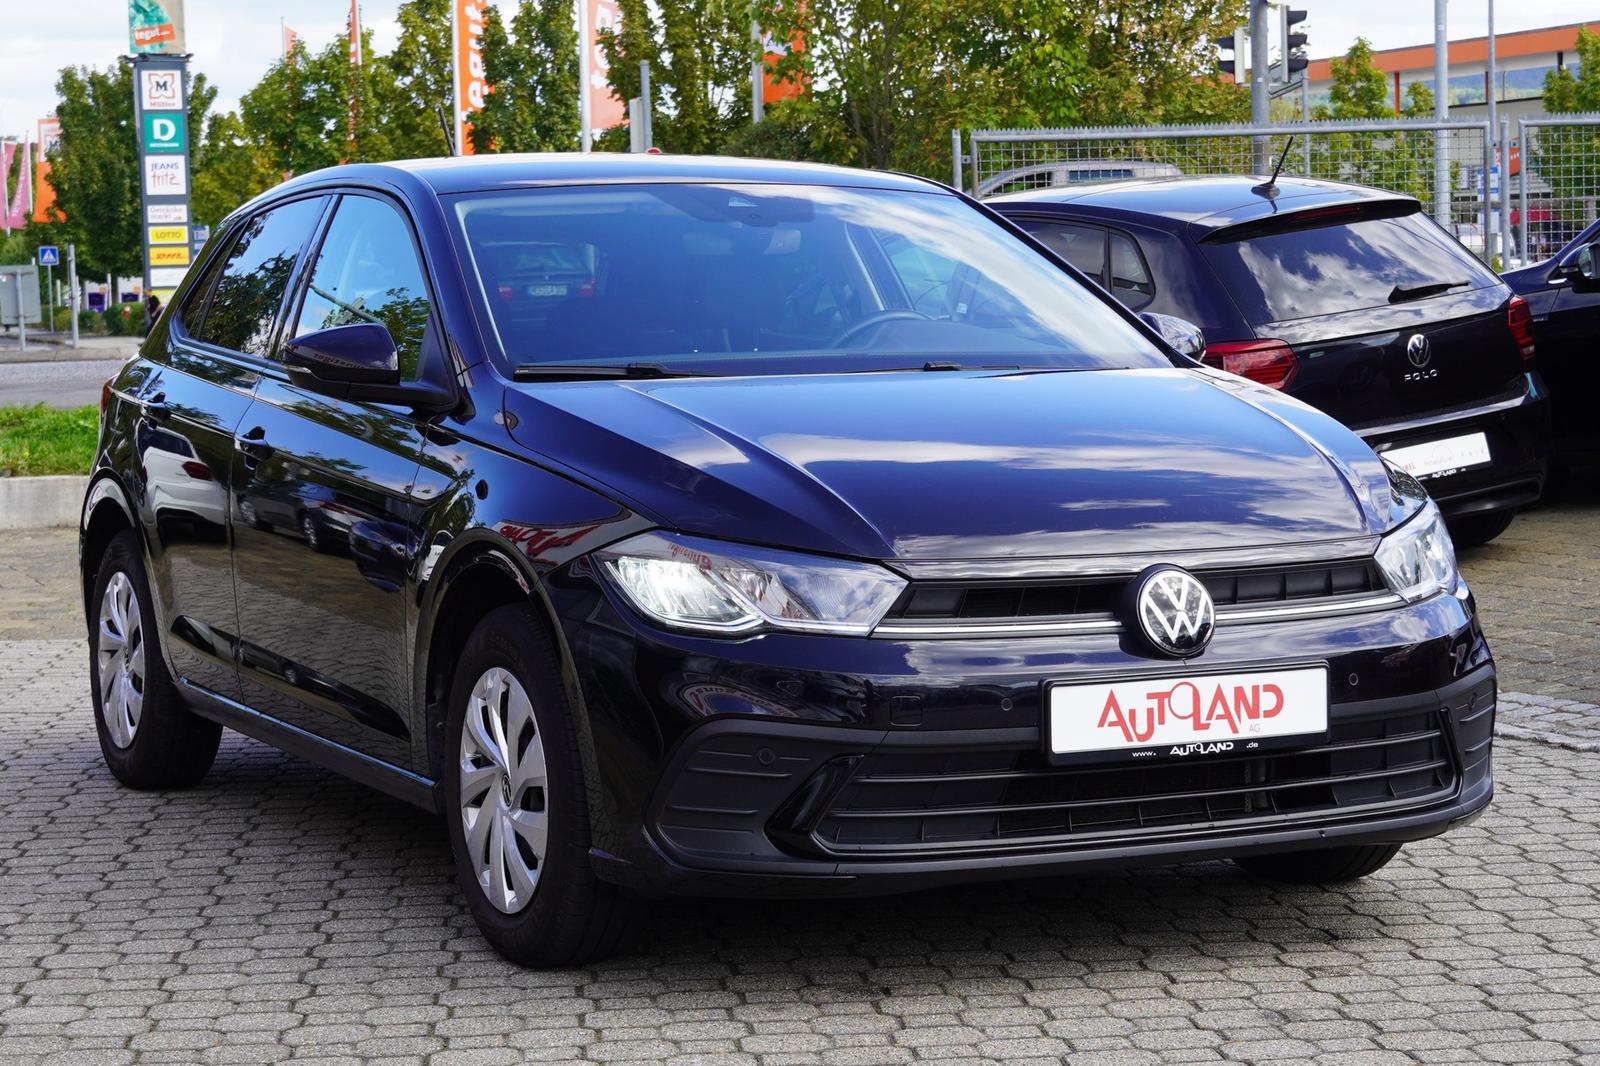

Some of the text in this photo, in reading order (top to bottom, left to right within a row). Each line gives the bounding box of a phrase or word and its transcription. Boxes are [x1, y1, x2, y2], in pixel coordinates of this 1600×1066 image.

[155, 81, 168, 91] M
[153, 118, 176, 141] D
[151, 162, 180, 171] JEANS
[155, 231, 182, 240] LOTTO
[1404, 369, 1438, 381] POLO
[1248, 723, 1261, 733] AG
[1131, 750, 1157, 758] www.
